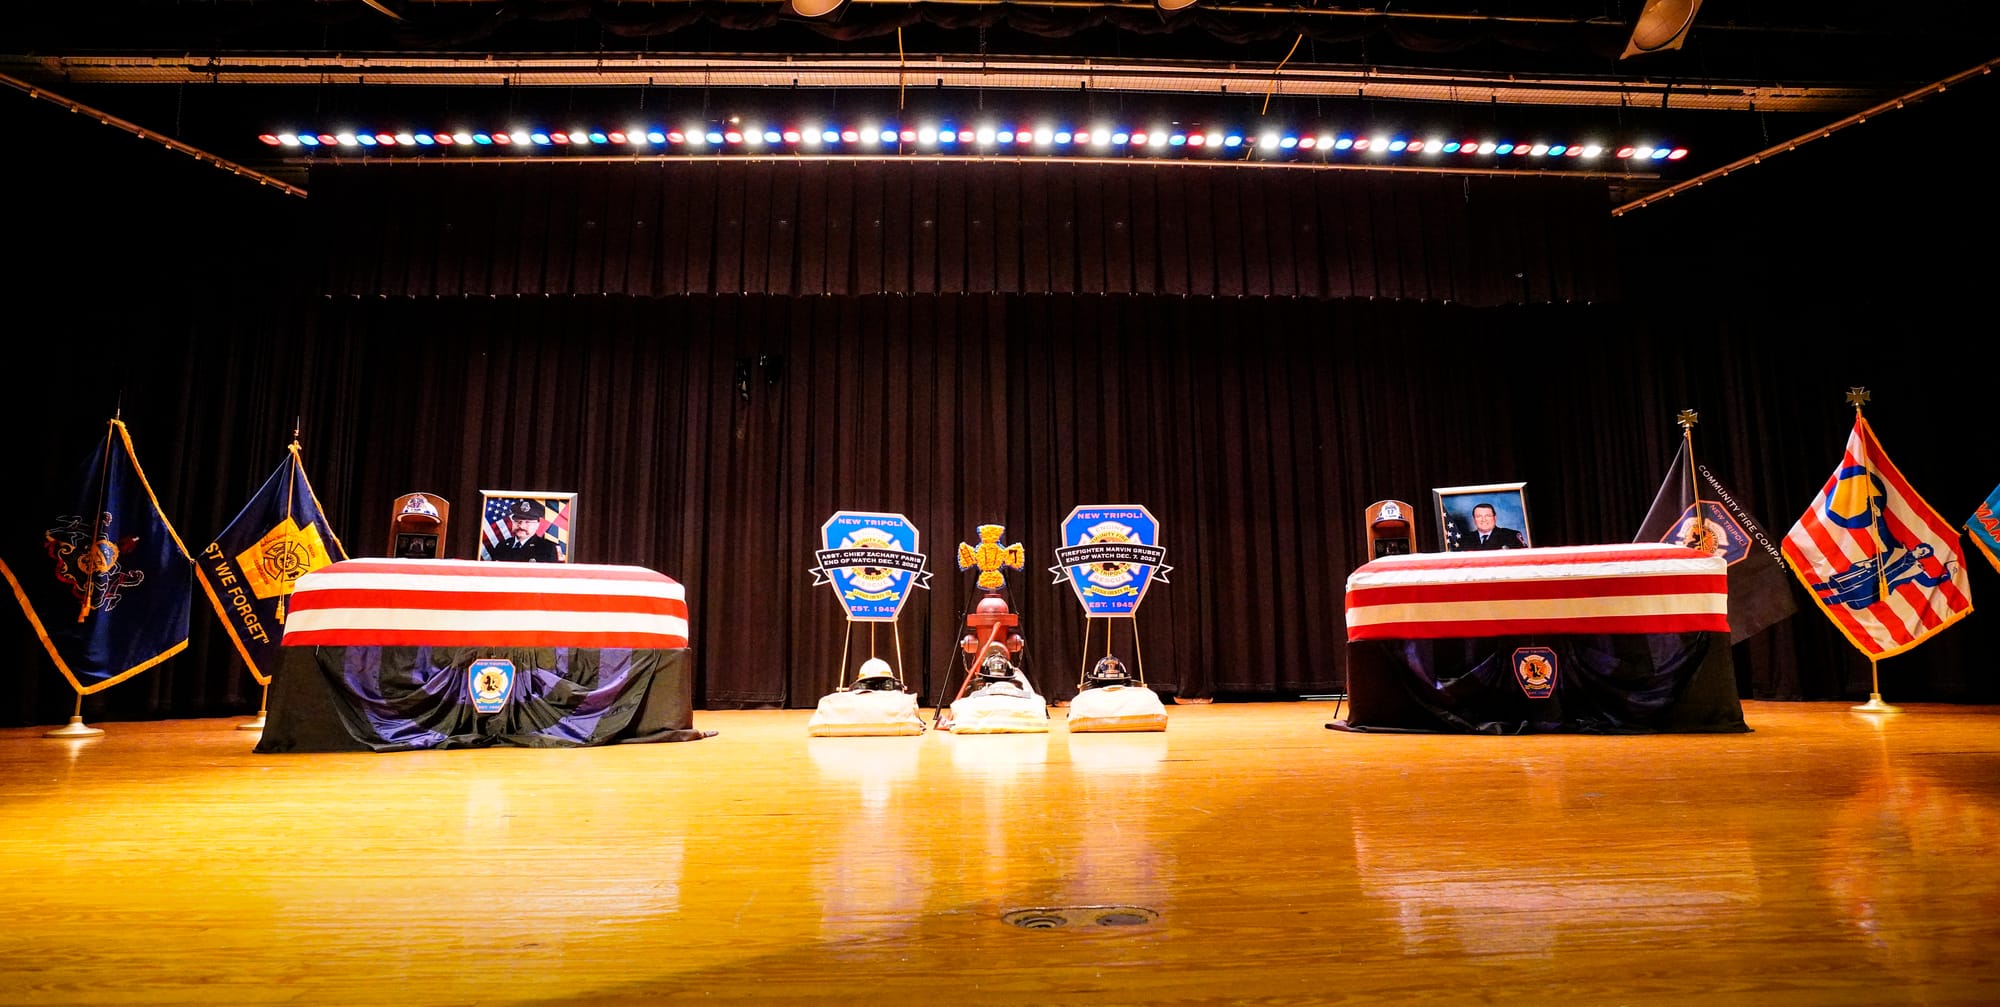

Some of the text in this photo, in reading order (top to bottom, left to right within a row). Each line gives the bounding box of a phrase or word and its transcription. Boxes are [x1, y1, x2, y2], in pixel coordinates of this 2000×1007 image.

[1698, 464, 1741, 512] COMMUNITY
[1737, 512, 1758, 533] FIRE
[1754, 532, 1787, 573] COMPAN
[1710, 504, 1748, 547] NEW TRIPOLI
[866, 551, 899, 559] ZACHARY
[900, 555, 921, 563] PARIS
[1061, 548, 1104, 558] FIREFIGHTER
[1133, 548, 1160, 556] GRUBER
[215, 562, 236, 586] WE
[228, 586, 270, 644] FORGET"
